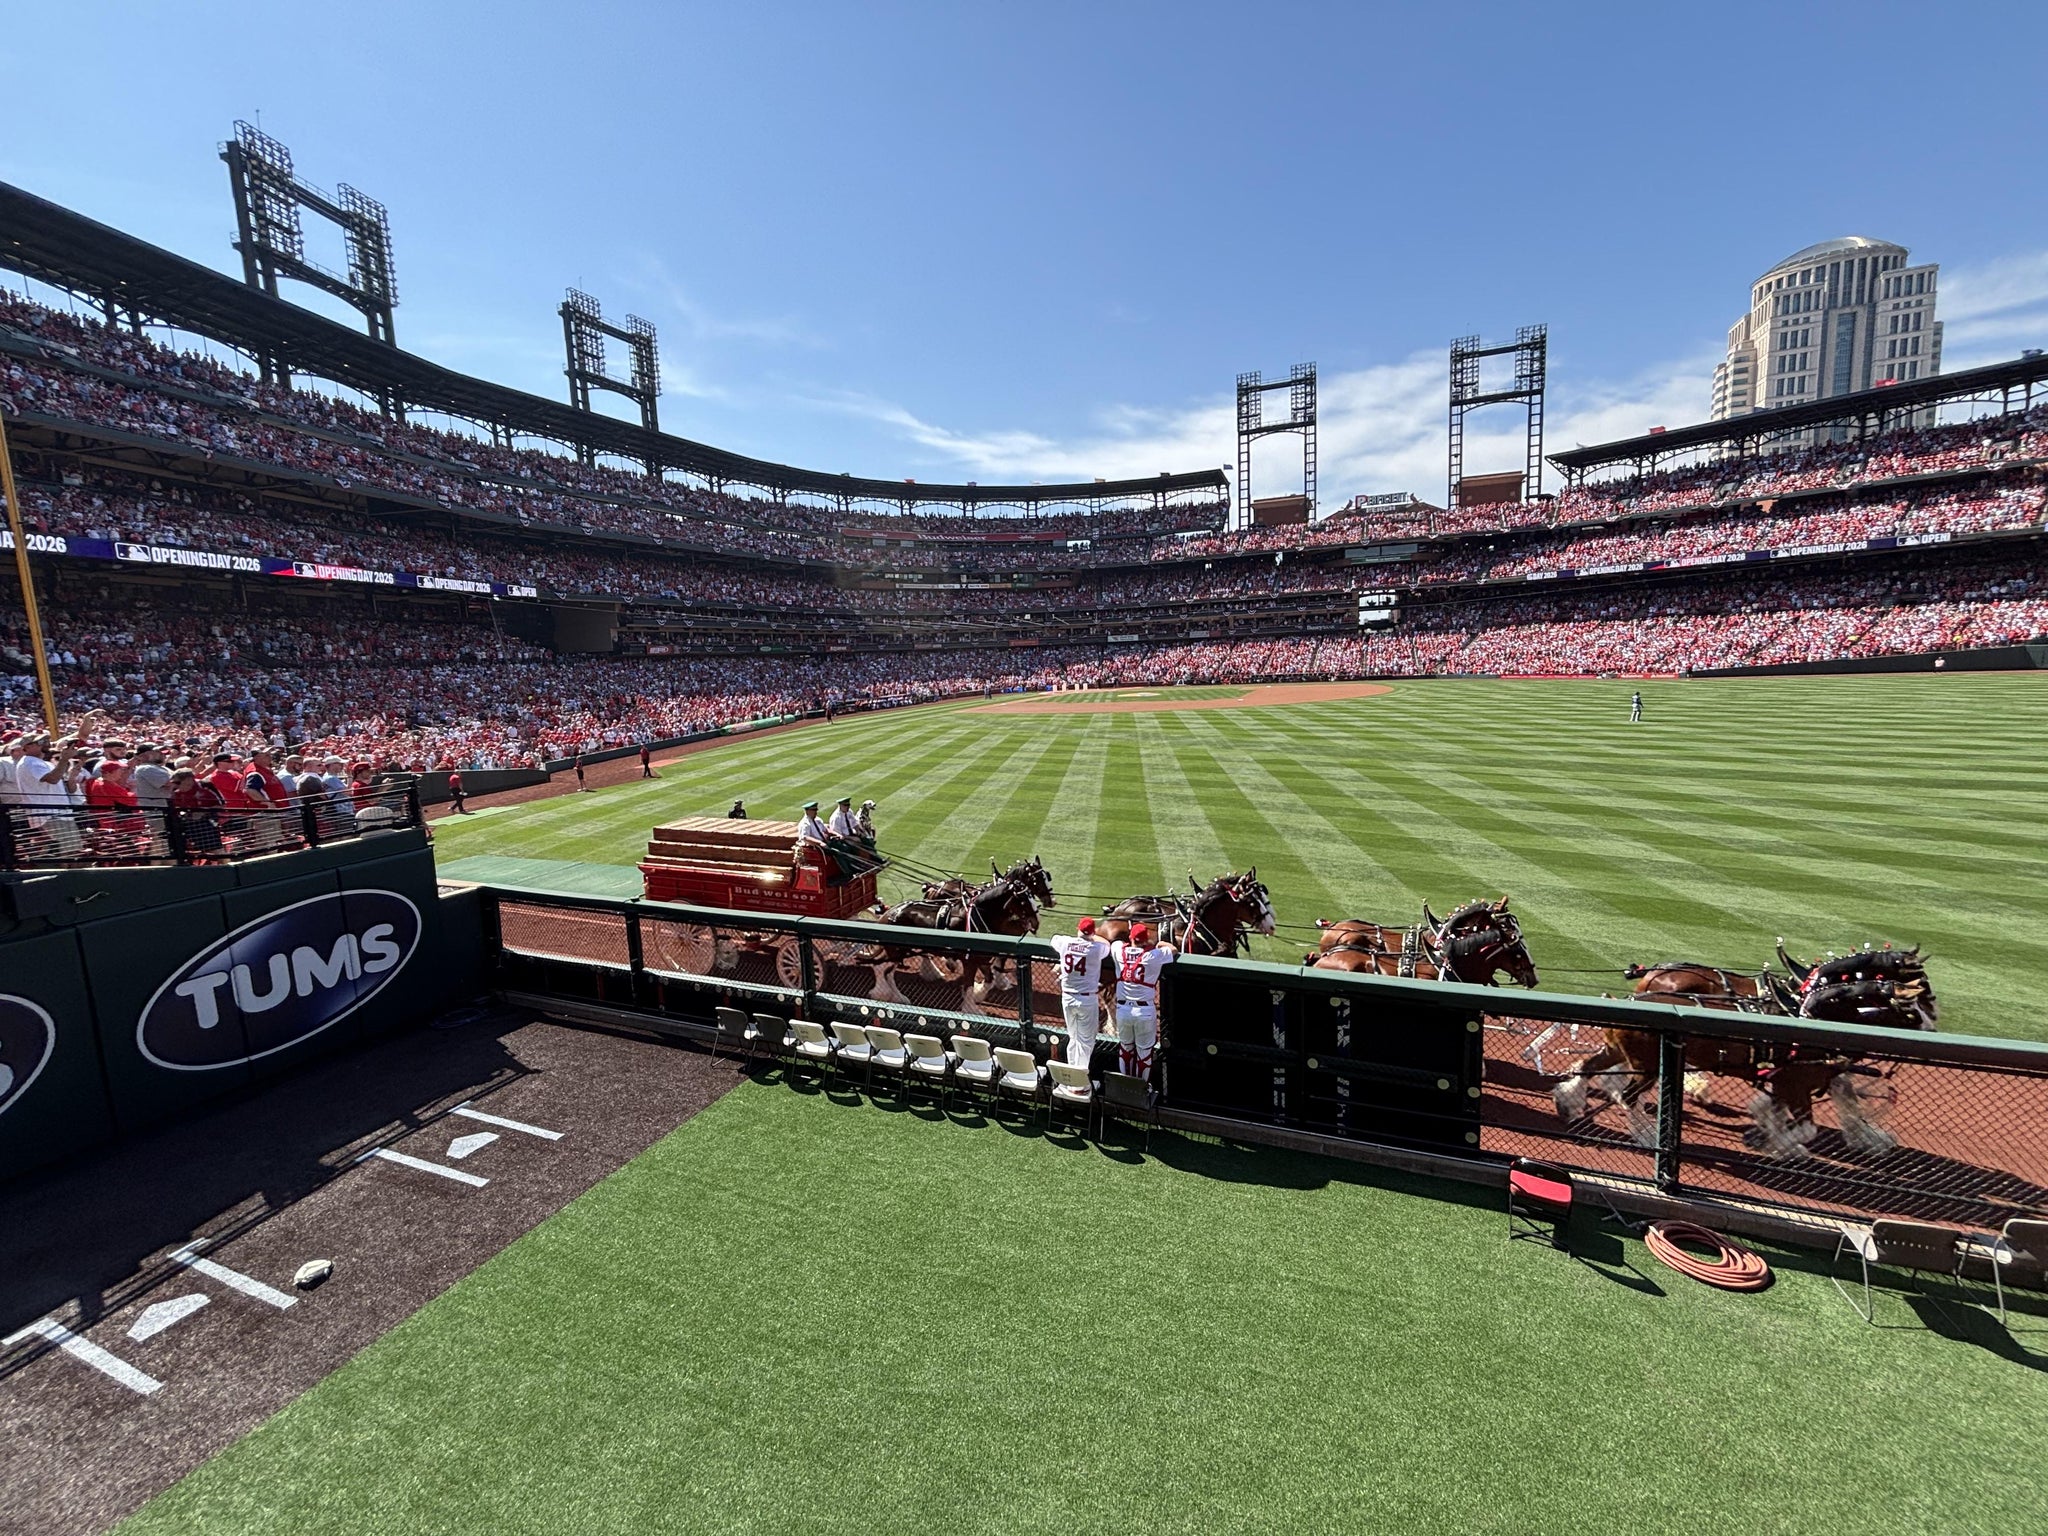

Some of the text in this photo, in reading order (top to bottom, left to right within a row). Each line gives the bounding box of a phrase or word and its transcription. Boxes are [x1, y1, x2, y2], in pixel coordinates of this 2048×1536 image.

[25, 533, 67, 553] 2026
[1791, 541, 1868, 556] OPENING DAY 2026
[151, 547, 260, 571] OPENING DAY 2026
[1627, 563, 1643, 571] 2026
[1682, 553, 1746, 567] OPENING DAY 2026
[317, 565, 394, 584] OPENING DAY 2026
[435, 578, 491, 593] OPENING DAY 2026
[735, 886, 816, 901] Budweiser
[1064, 953, 1087, 976] 94
[175, 924, 400, 1028] TUMS
